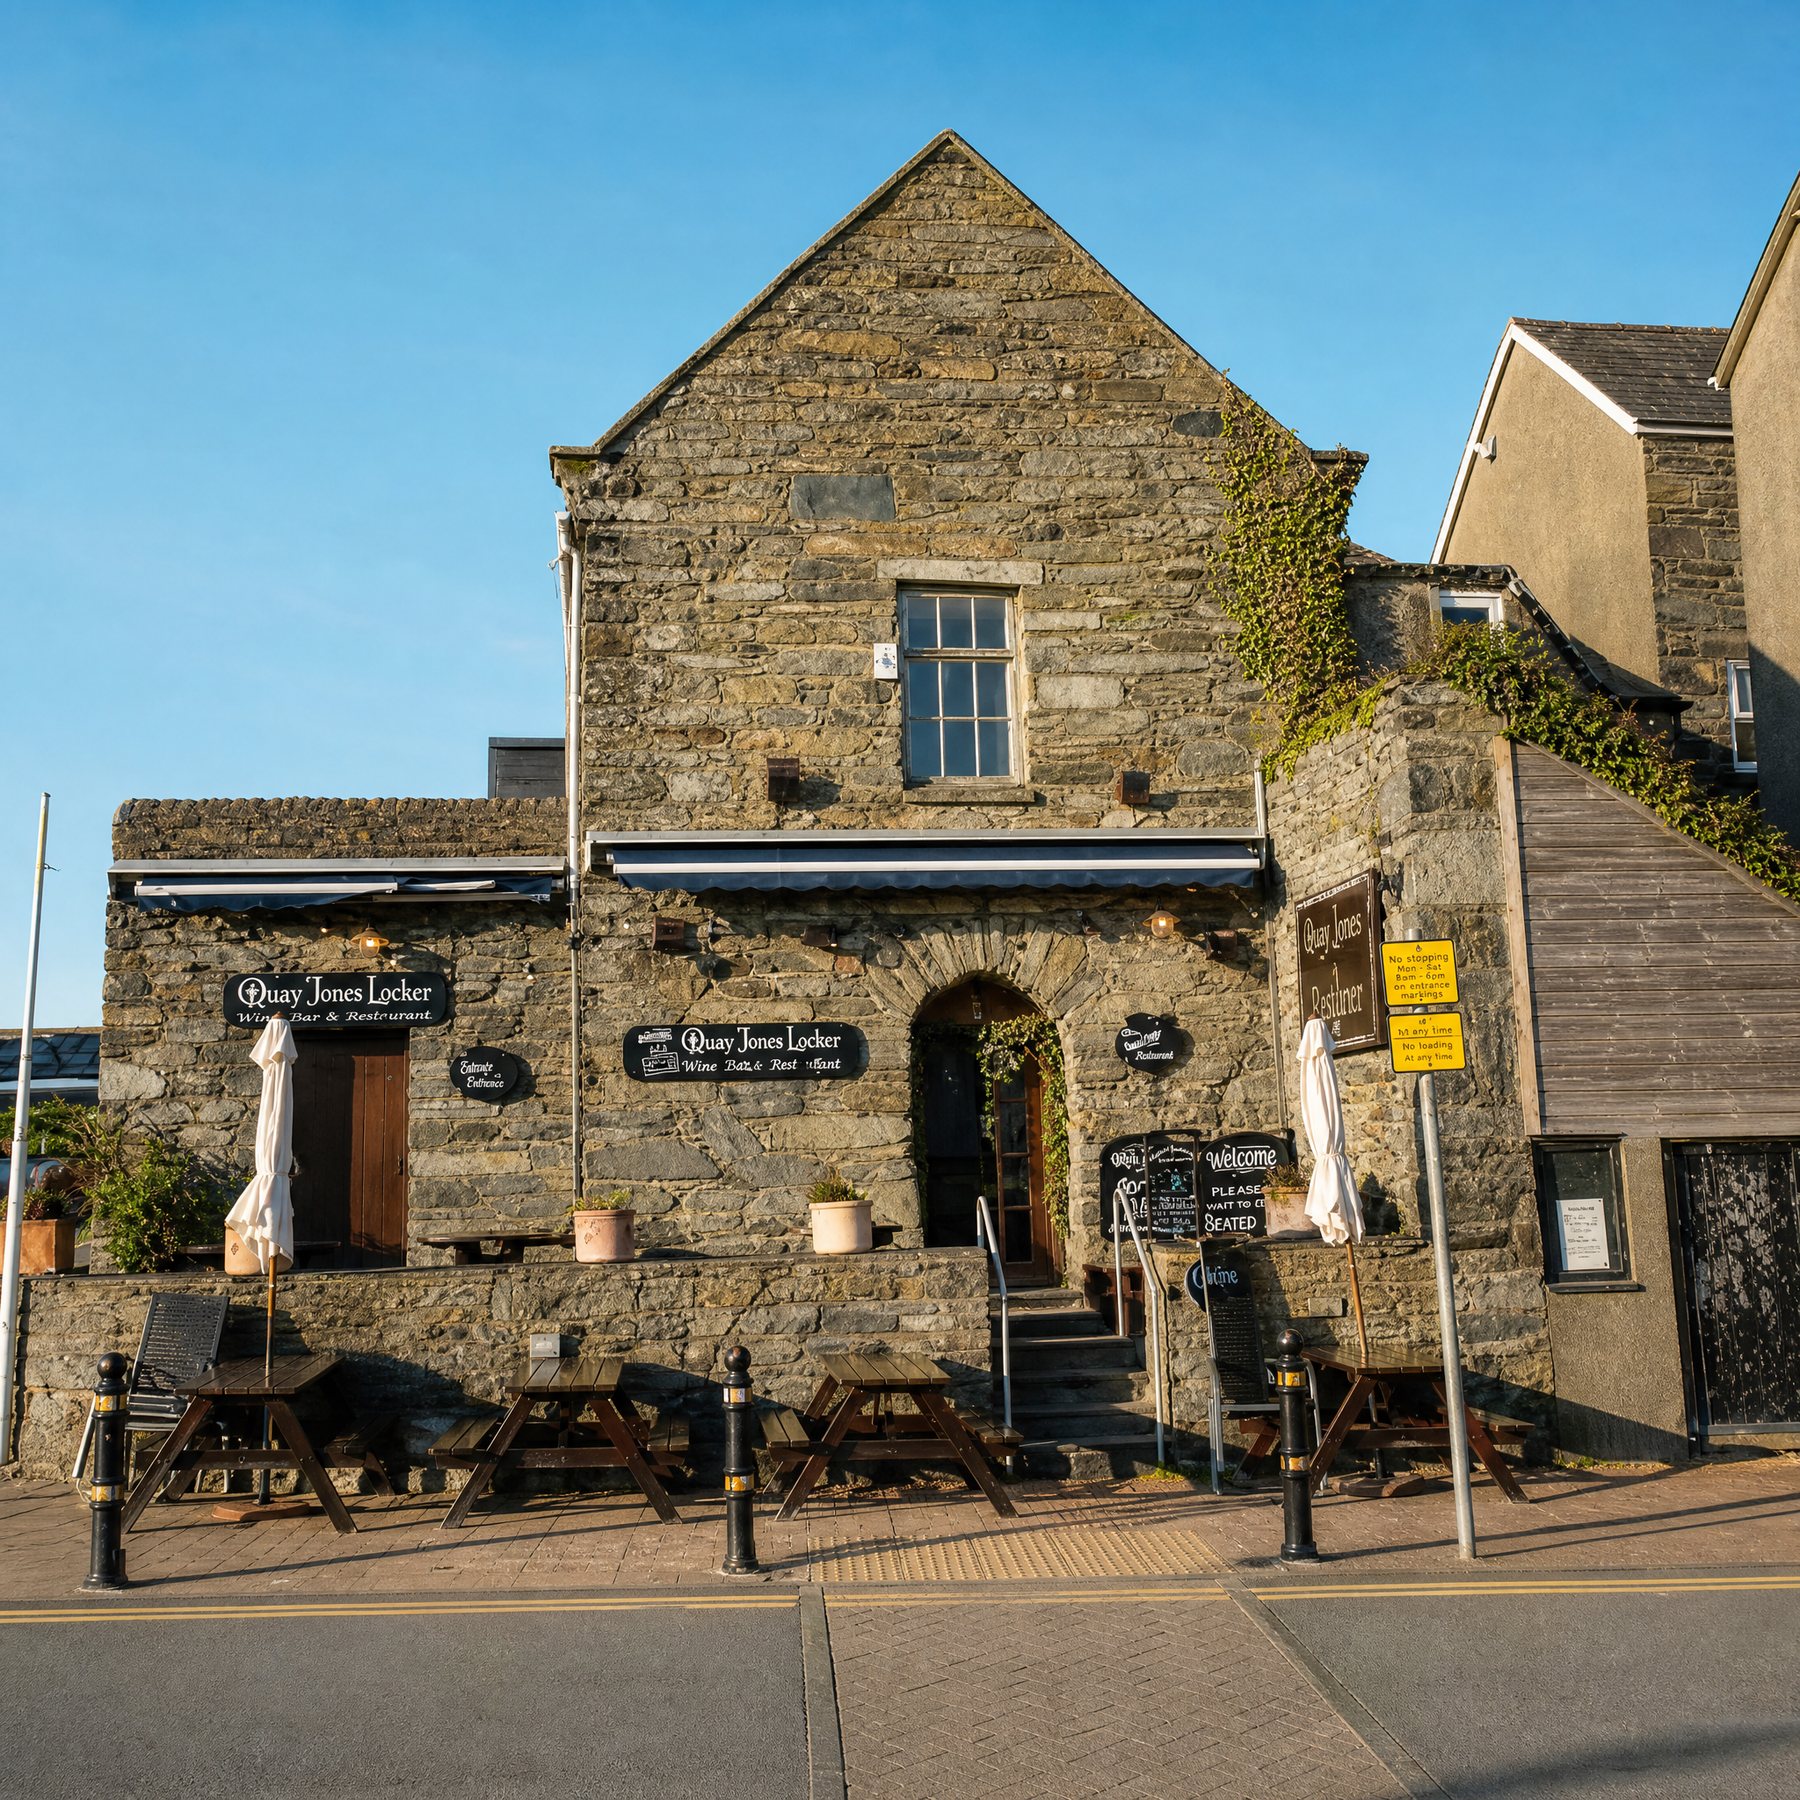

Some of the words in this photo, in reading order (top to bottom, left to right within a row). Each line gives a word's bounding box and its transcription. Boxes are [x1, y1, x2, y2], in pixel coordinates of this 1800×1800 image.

[1303, 916, 1331, 955] Quay
[1331, 903, 1362, 949] Jones
[1389, 955, 1403, 963] No
[1406, 953, 1449, 963] stopping
[1426, 963, 1442, 971] Sat
[1425, 972, 1445, 980] 6pm
[237, 977, 303, 1008] Quay
[305, 976, 363, 1007] Jones
[366, 975, 432, 1005] Locker
[1409, 982, 1450, 990] entrance
[1401, 990, 1443, 999] markings
[236, 1012, 272, 1023] Win
[289, 1012, 321, 1022] Bar
[325, 1011, 340, 1021] &
[1431, 1026, 1452, 1034] time
[681, 1027, 735, 1055] Quay
[736, 1026, 783, 1052] Jones
[786, 1025, 841, 1052] Locker
[1418, 1041, 1453, 1050] loading
[681, 1059, 717, 1072] Wine
[753, 1060, 763, 1070] &
[1205, 1147, 1277, 1170] Welcome
[1211, 1184, 1262, 1197] PLEASE
[1206, 1201, 1235, 1211] WAIT
[1236, 1200, 1252, 1209] TO
